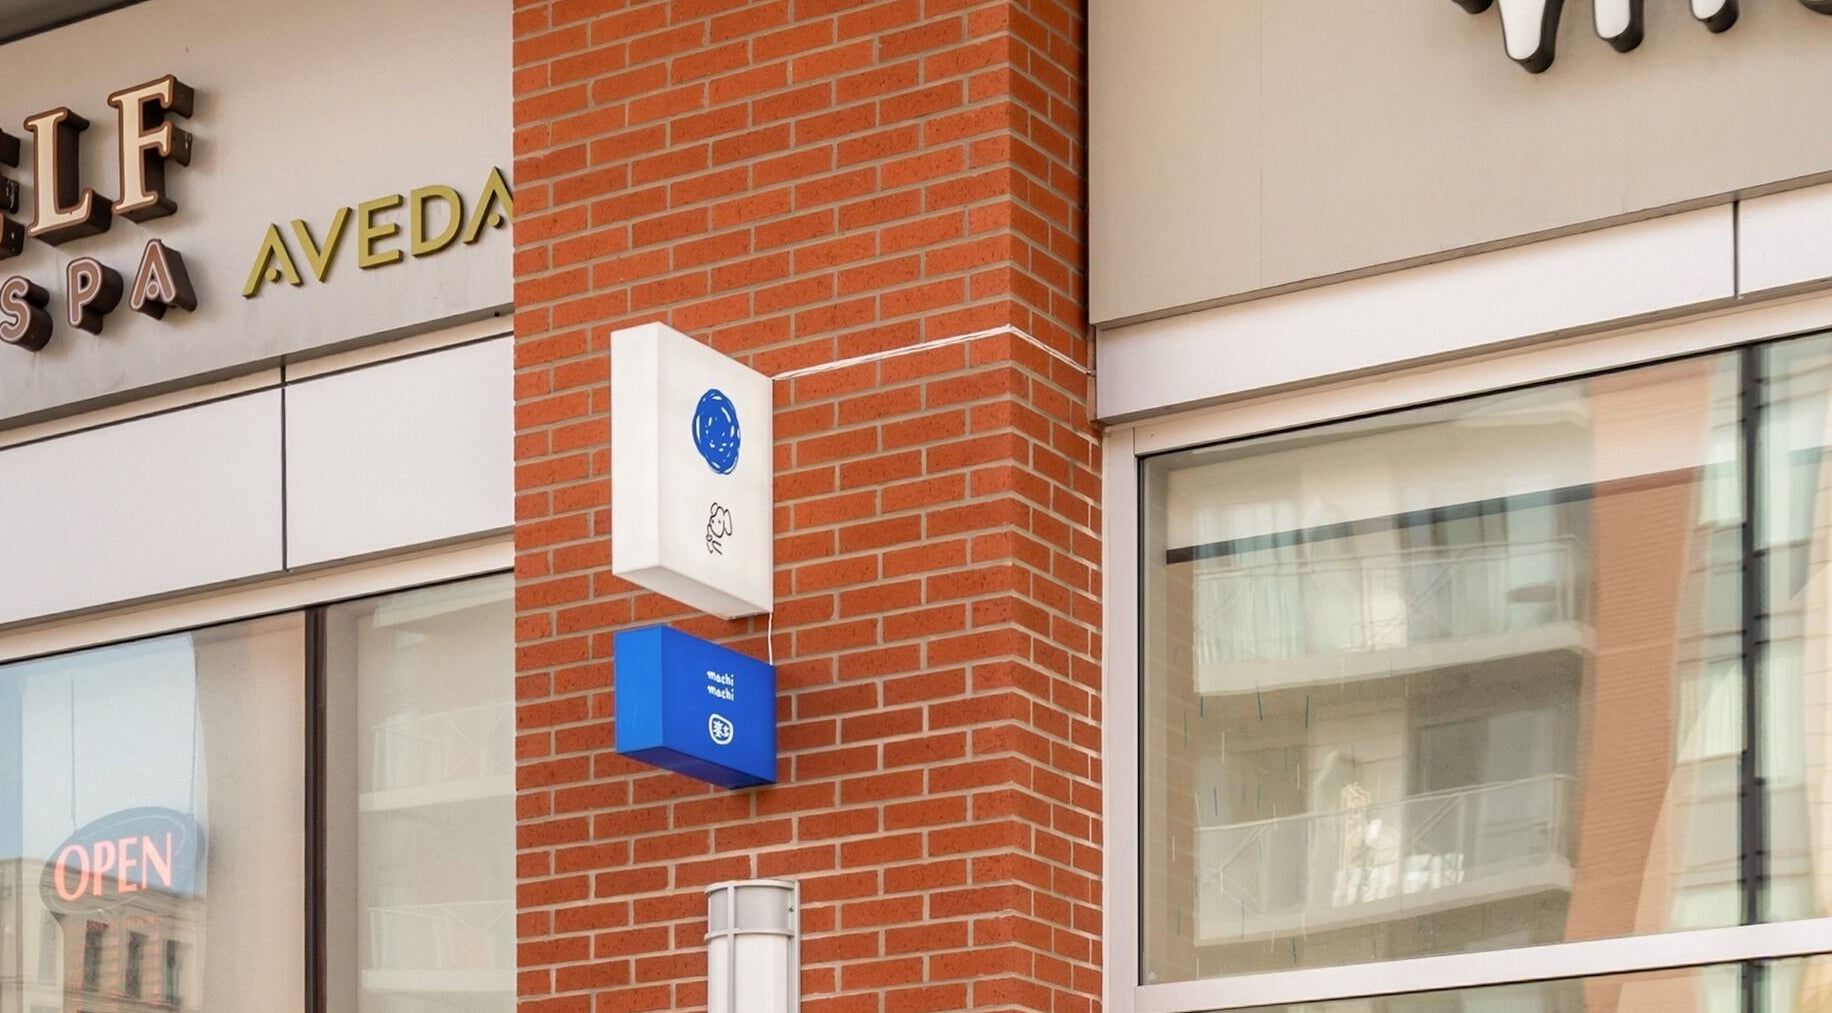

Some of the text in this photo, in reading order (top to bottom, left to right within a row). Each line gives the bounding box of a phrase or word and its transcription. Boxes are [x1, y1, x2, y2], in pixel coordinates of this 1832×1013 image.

[242, 166, 513, 299] AVEDA
[707, 670, 734, 687] machi
[707, 685, 735, 701] machi
[54, 831, 173, 901] OPEN
